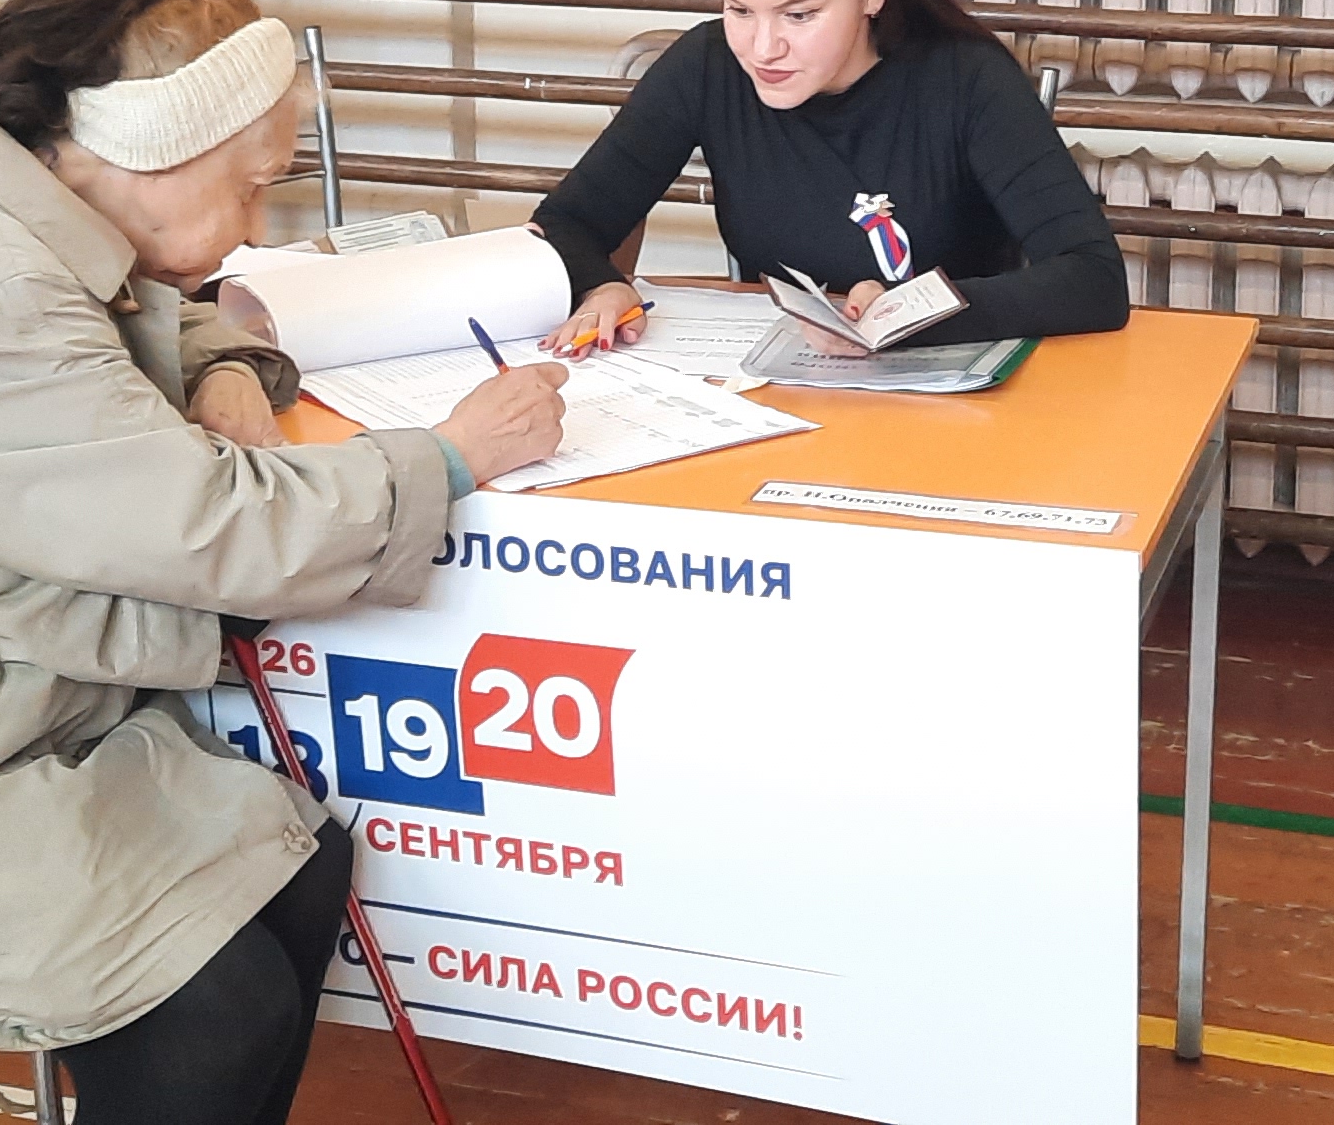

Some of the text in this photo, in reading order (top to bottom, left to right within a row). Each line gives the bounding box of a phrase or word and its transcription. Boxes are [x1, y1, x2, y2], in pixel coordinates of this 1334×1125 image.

[343, 693, 450, 779] 19
[470, 667, 603, 759] 20
[366, 816, 624, 887] СЕНТЯБРЯ
[427, 944, 563, 999] СИЛА
[577, 967, 804, 1042] РОССИИ!
